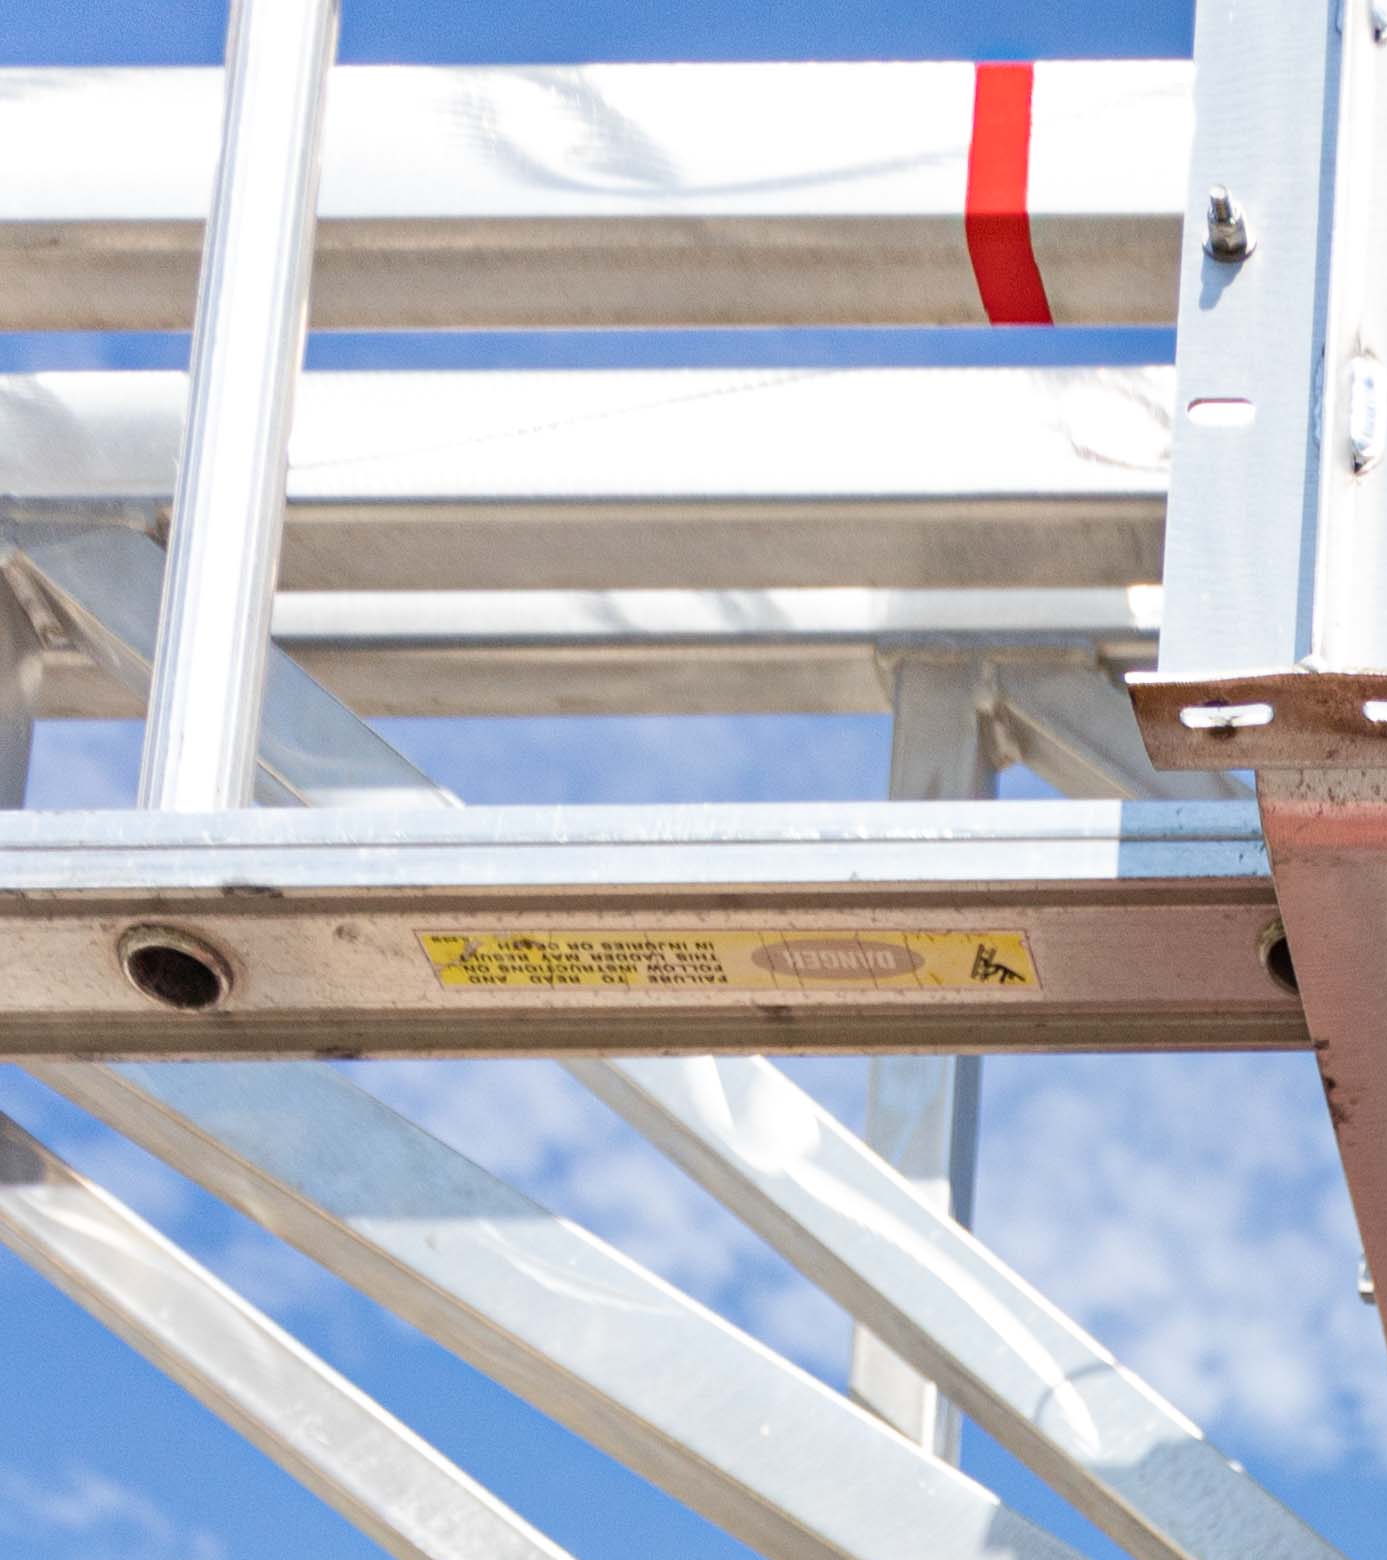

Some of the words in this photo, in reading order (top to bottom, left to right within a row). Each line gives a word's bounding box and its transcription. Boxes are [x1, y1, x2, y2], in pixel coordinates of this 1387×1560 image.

[567, 942, 593, 951] OR
[601, 942, 687, 951] INJURIES
[696, 942, 715, 951] IN
[542, 953, 580, 962] MAY
[590, 953, 666, 962] LADDER
[676, 953, 717, 962] THIS
[783, 951, 896, 970] DANGER
[463, 965, 490, 973] ON
[498, 964, 638, 973] INSTRUCTIONS
[647, 964, 722, 973] FOLLOW
[468, 976, 508, 984] AND
[529, 976, 581, 984] READ
[601, 976, 624, 984] TO
[648, 976, 728, 984] FAILURE
